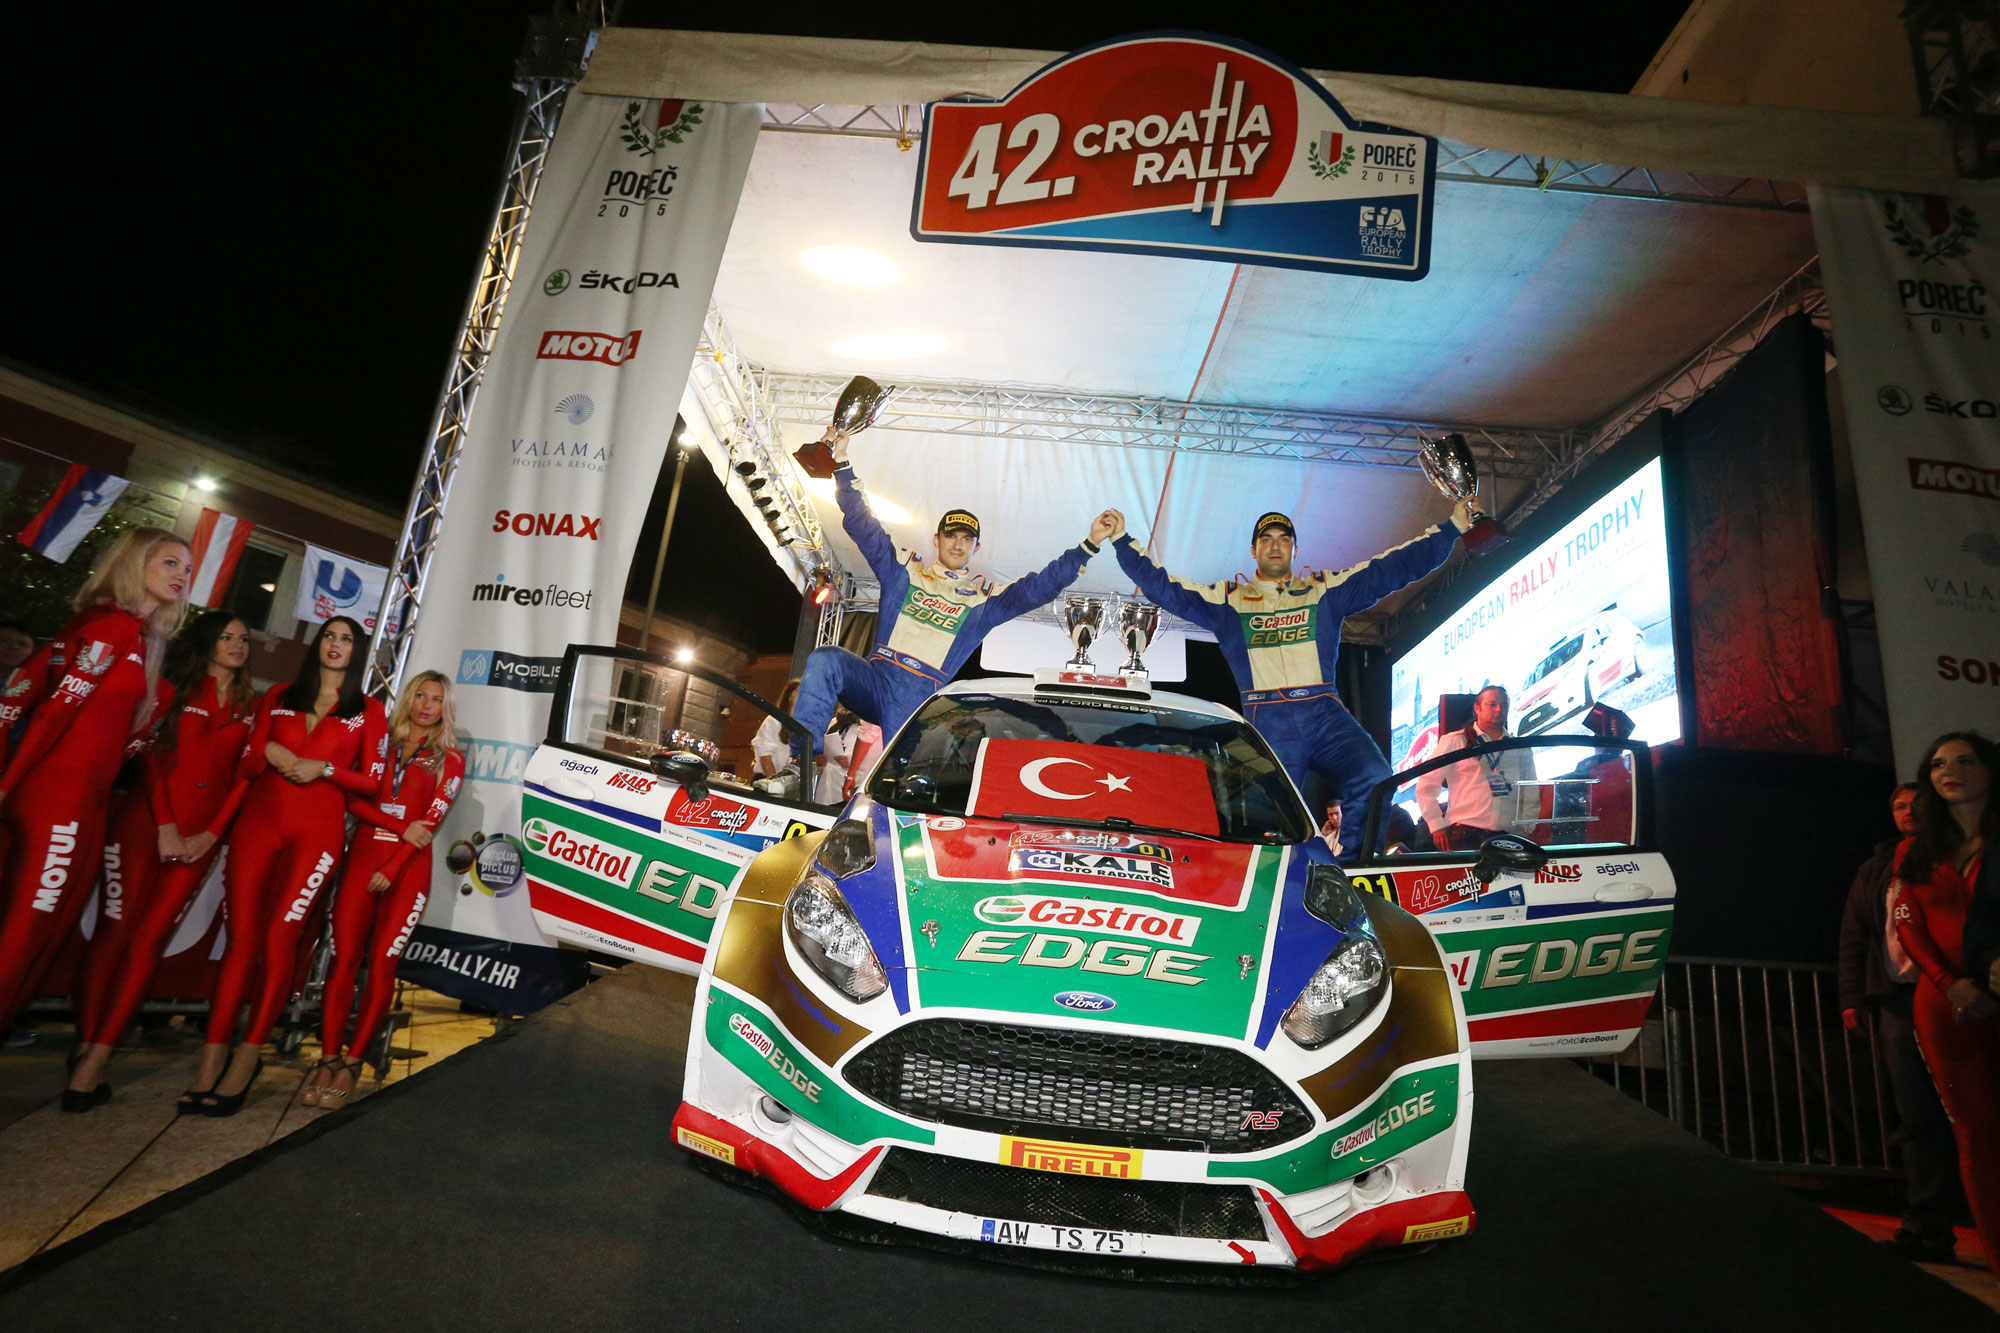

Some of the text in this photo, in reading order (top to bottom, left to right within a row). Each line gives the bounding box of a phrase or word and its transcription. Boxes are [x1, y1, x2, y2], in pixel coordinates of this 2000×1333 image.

[947, 66, 1271, 210] 42. CROATIA
[1363, 143, 1416, 168] POREČ
[605, 165, 679, 200] POREČ
[1132, 141, 1270, 212] RALLY
[1362, 170, 1415, 185] 2015
[598, 203, 667, 218] 205
[1360, 227, 1406, 239] EUROPEAN
[1361, 236, 1403, 249] RALLY
[1362, 245, 1402, 257] TROPHY
[1897, 278, 1986, 315] POREČ
[1924, 391, 2000, 419] ŠKO
[493, 509, 602, 541] SONAX
[1444, 592, 1505, 656] EUROPEAN
[1510, 551, 1558, 607] RALLY
[1564, 488, 1644, 567] TROPHY
[903, 603, 960, 630] EDGE
[922, 597, 961, 616] Castrol
[1264, 610, 1306, 630] Castrol
[1250, 626, 1311, 646] EDGE
[711, 804, 748, 822] CROATIA
[719, 817, 745, 833] RALLY
[33, 820, 80, 913] MOTUL
[1065, 852, 1171, 881] KALE
[1139, 844, 1167, 860] 01
[104, 842, 122, 920] MOTUL
[482, 862, 516, 875] pictus
[547, 830, 728, 919] Castrol ED
[1063, 866, 1092, 874] OTO
[284, 851, 334, 923] MOTUL
[1411, 876, 1449, 911] 42.
[1458, 882, 1482, 899] RALLY
[386, 891, 428, 958] MOTUL
[1028, 899, 1184, 941] Castrol
[404, 941, 521, 990] ORALLY.HR
[955, 929, 1214, 986] EDGE
[1481, 928, 1668, 990] EDGE
[1060, 991, 1110, 1012] Ford
[740, 1023, 823, 1104] Castrol EDGE
[1240, 1111, 1283, 1130] RS
[1343, 1090, 1436, 1154] Castrol EDGE
[1011, 1140, 1131, 1178] PIRELLI
[998, 1222, 1030, 1245] AW
[1051, 1227, 1083, 1250] TS
[1093, 1231, 1124, 1253] 75
[1410, 1221, 1464, 1241] PIRELLI
